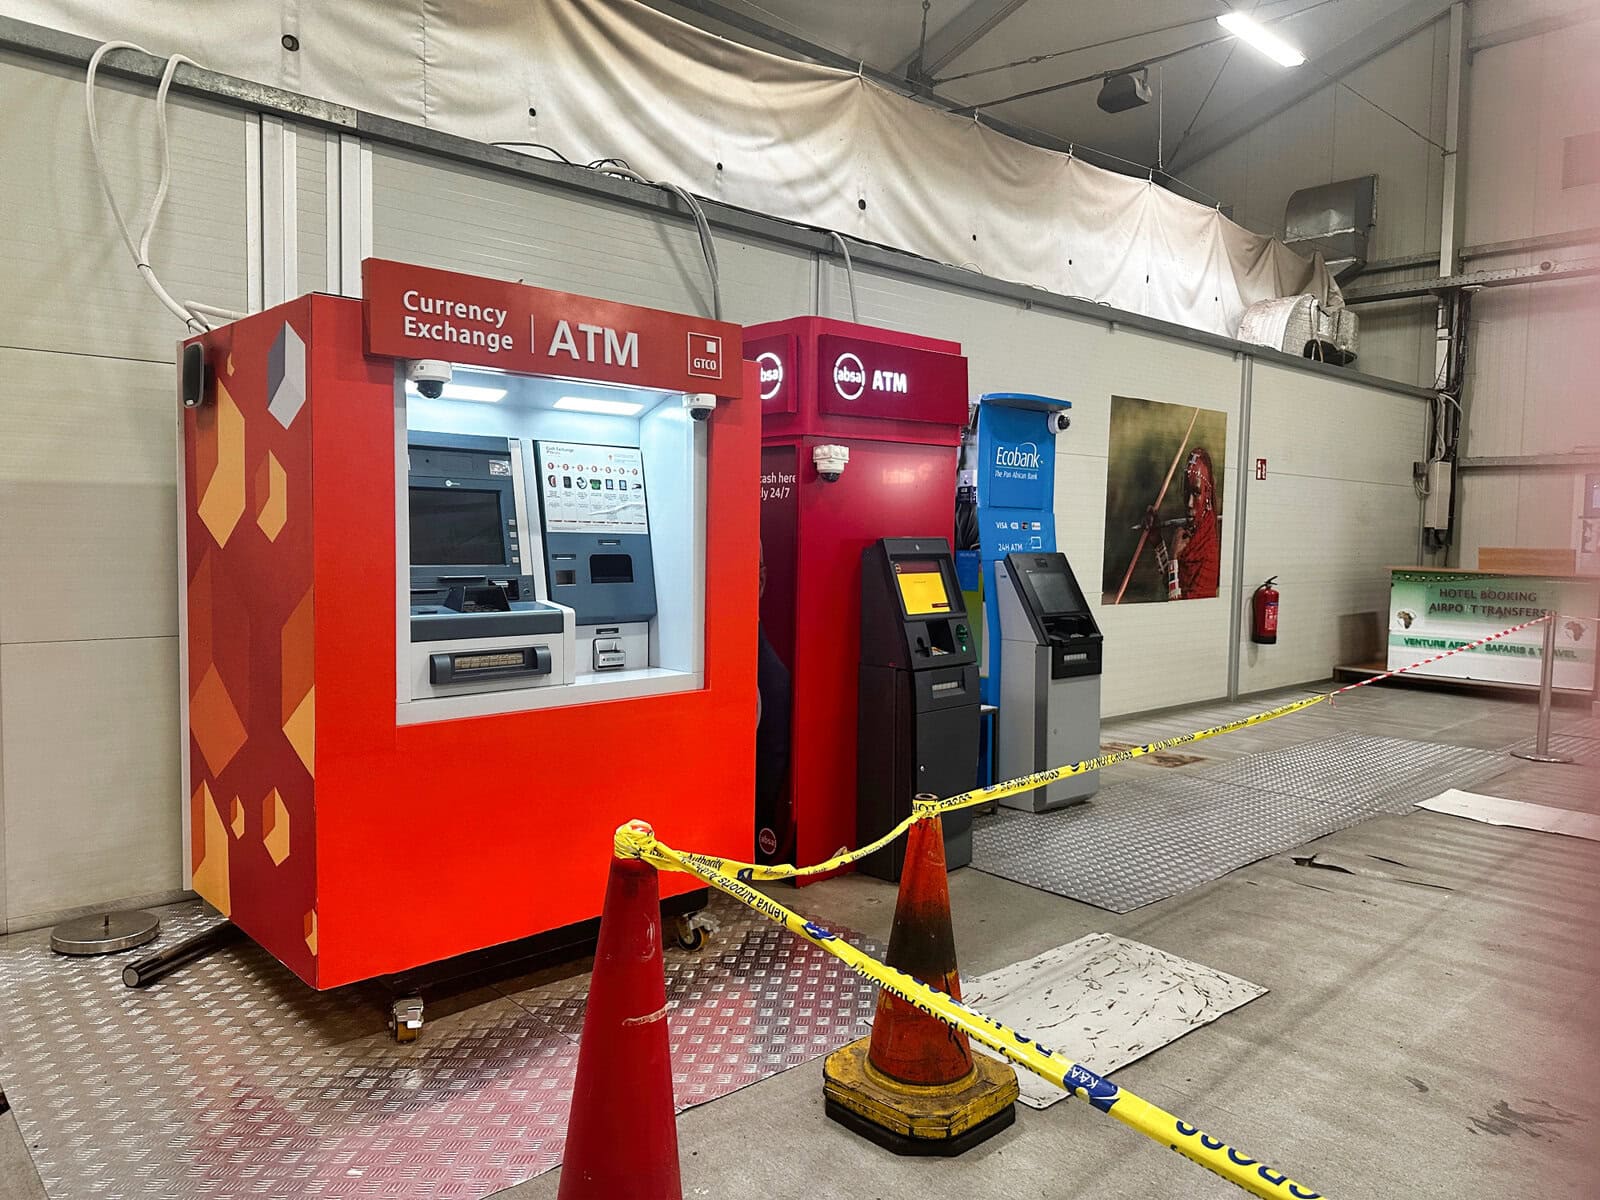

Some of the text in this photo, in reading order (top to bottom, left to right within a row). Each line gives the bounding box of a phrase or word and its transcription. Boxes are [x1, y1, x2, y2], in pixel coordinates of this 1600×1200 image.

[403, 290, 507, 329] Currency
[404, 316, 513, 353] Exchange
[548, 319, 638, 368] ATM
[694, 358, 717, 370] GTCO
[760, 367, 780, 382] bsa
[837, 366, 907, 393] absa ATM
[996, 442, 1040, 468] Ecobank
[760, 472, 777, 484] ash
[770, 486, 790, 499] 24/7
[995, 521, 1008, 530] VISA
[998, 543, 1023, 552] 24H ATM
[1439, 589, 1537, 602] HOTEL BOOKING
[1429, 602, 1547, 618] AIRPOT TRANSFERS
[1404, 637, 1446, 649] VENTURE
[1485, 643, 1526, 655] SAFARIS
[1071, 1065, 1099, 1090] KAA
